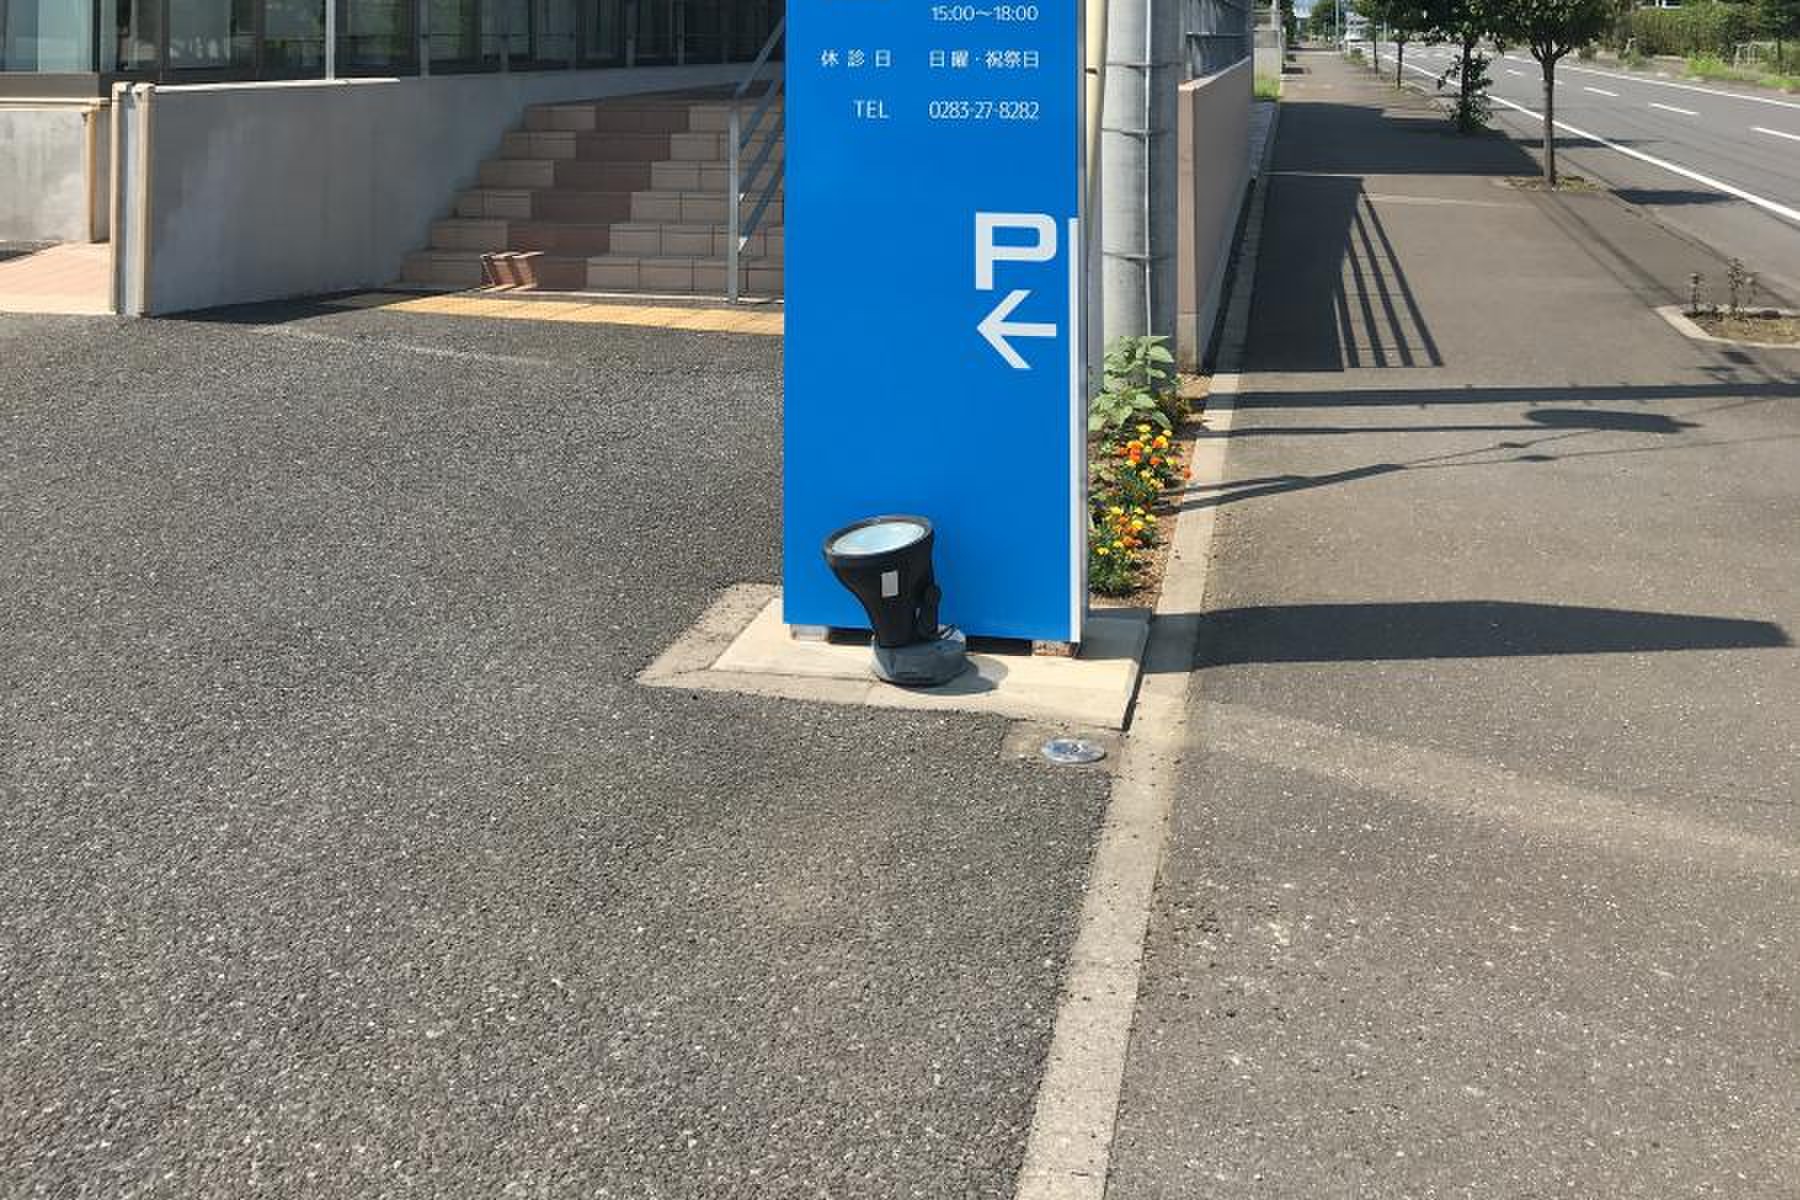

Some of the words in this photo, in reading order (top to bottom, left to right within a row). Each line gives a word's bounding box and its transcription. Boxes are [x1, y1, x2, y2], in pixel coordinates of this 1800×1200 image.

[821, 49, 891, 68] 休診日
[854, 100, 889, 119] TEL
[929, 101, 1039, 119] 0283-27-8282
[975, 212, 1057, 290] P
